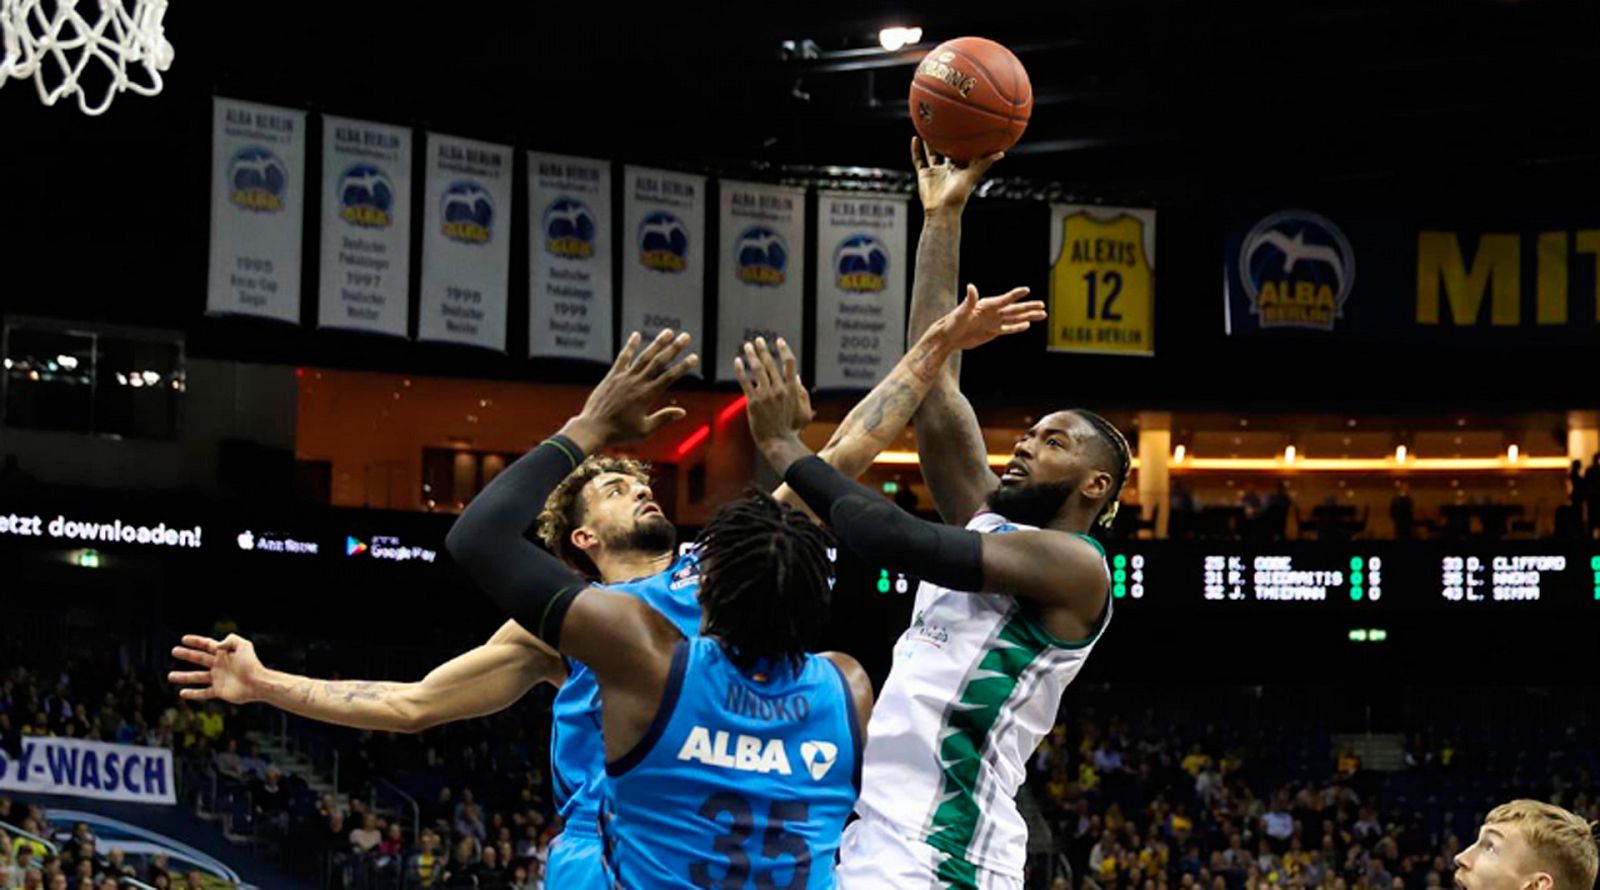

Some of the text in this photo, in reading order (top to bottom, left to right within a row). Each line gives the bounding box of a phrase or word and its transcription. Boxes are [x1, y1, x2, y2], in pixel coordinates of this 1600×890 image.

[225, 108, 293, 132] ALBA BERLIN
[335, 127, 400, 148] ALBA BERLIN
[438, 144, 502, 166] ALBA BERLIN
[538, 163, 600, 180] ALBA BERLIN
[636, 176, 695, 196] ALBA BERLIN
[731, 194, 793, 209] ALBA BERLIN
[831, 203, 895, 217] ALBA BERLIN
[1070, 238, 1136, 268] ALEXIS
[1083, 270, 1123, 321] 12
[1258, 281, 1336, 307] ALBA
[554, 303, 588, 317] 1999
[1264, 305, 1330, 323] BERLIN
[841, 335, 881, 350] 2002
[1061, 327, 1143, 344] ALBA BERLIN
[48, 515, 202, 547] downloaden!
[1113, 554, 1144, 569] 0 0
[1350, 556, 1363, 571] 0
[1368, 556, 1381, 571] 0
[1493, 556, 1566, 571] CLIFFORD
[1113, 569, 1127, 583] 0
[1350, 571, 1363, 585] 0
[878, 579, 908, 593] 0 0
[1113, 583, 1144, 598] 0 0
[1350, 585, 1363, 600] 0
[1368, 586, 1381, 600] 0
[677, 726, 792, 775] ALBA
[0, 743, 167, 795] Y-WASCH
[688, 792, 812, 890] 35
